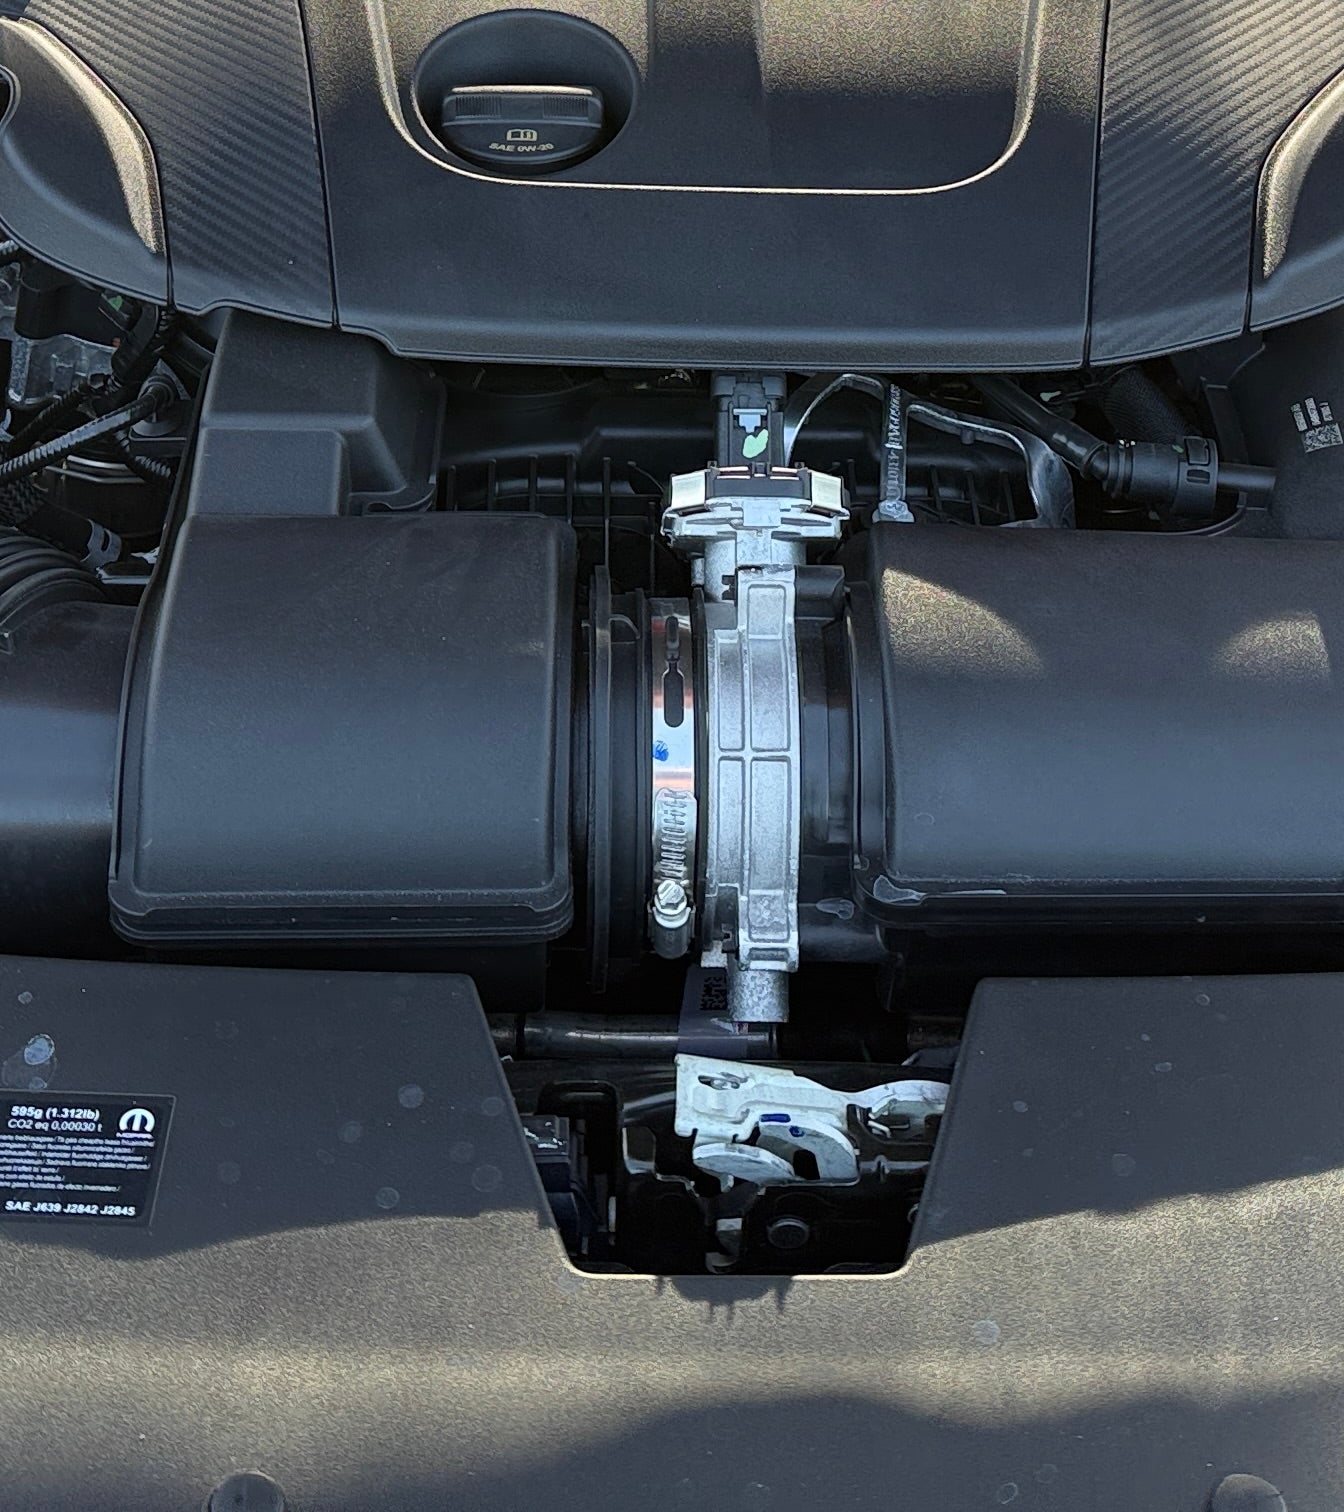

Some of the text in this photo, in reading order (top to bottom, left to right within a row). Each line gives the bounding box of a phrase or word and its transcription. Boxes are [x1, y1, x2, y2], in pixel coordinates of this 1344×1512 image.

[488, 142, 515, 152] SAE
[10, 1105, 100, 1122] 595g (1.312lb)
[7, 1118, 33, 1130] CO2
[4, 1200, 32, 1212] SAE
